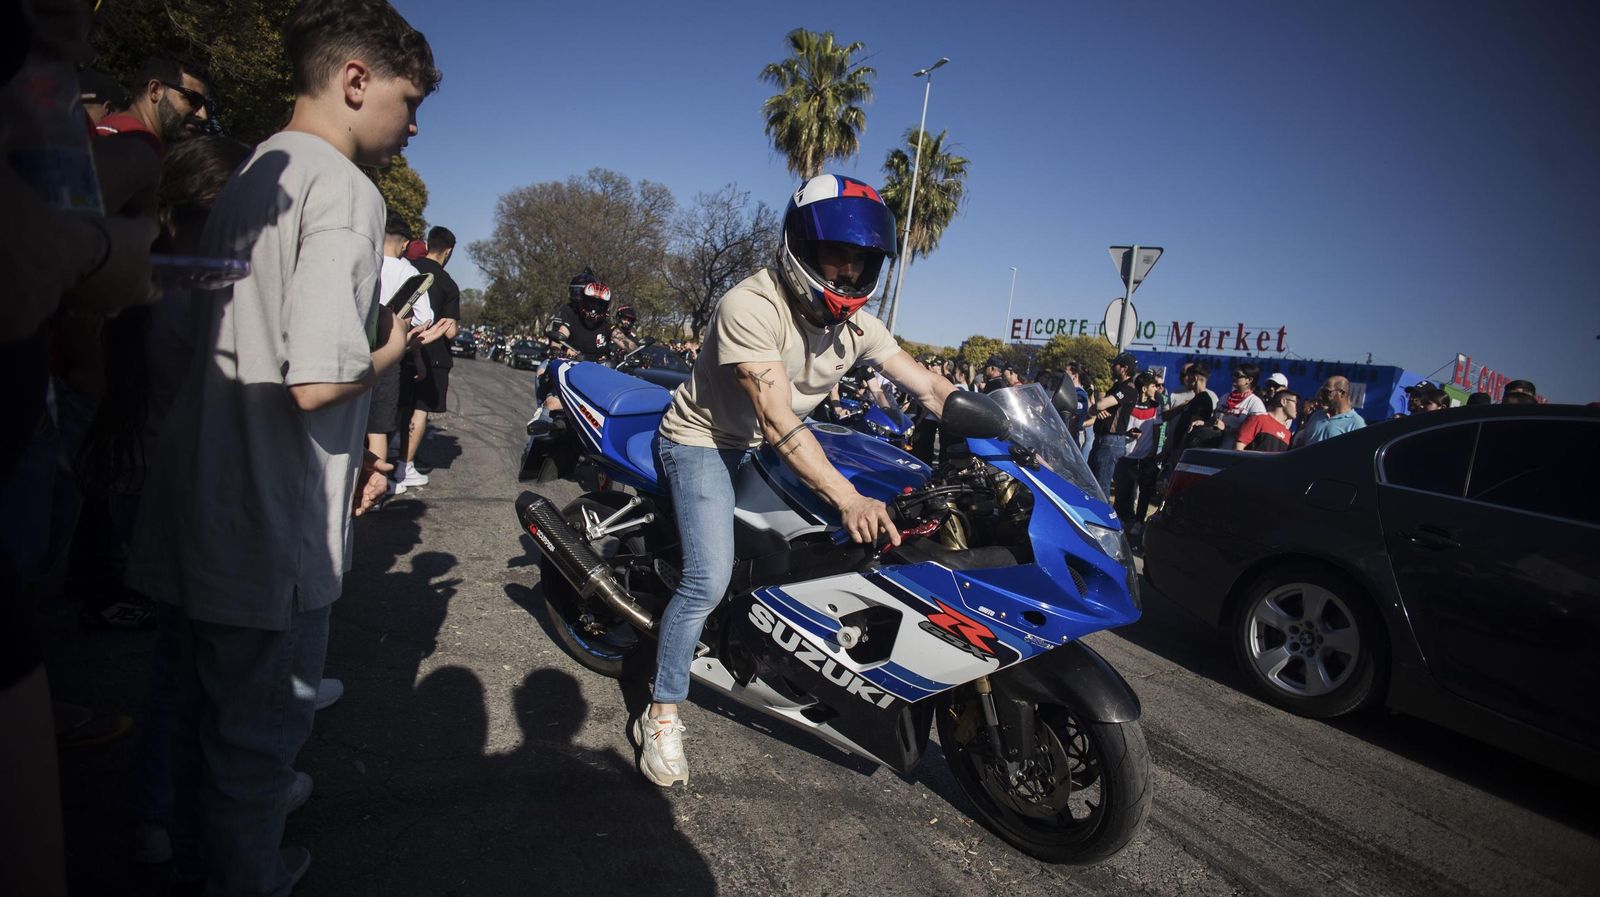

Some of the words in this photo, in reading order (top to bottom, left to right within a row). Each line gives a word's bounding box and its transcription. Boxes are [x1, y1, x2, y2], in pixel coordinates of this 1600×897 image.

[1034, 318, 1088, 336] CORTE
[1170, 320, 1287, 352] Market
[579, 404, 600, 429] 600
[748, 603, 898, 709] SUZUKI
[918, 620, 995, 662] GSX
